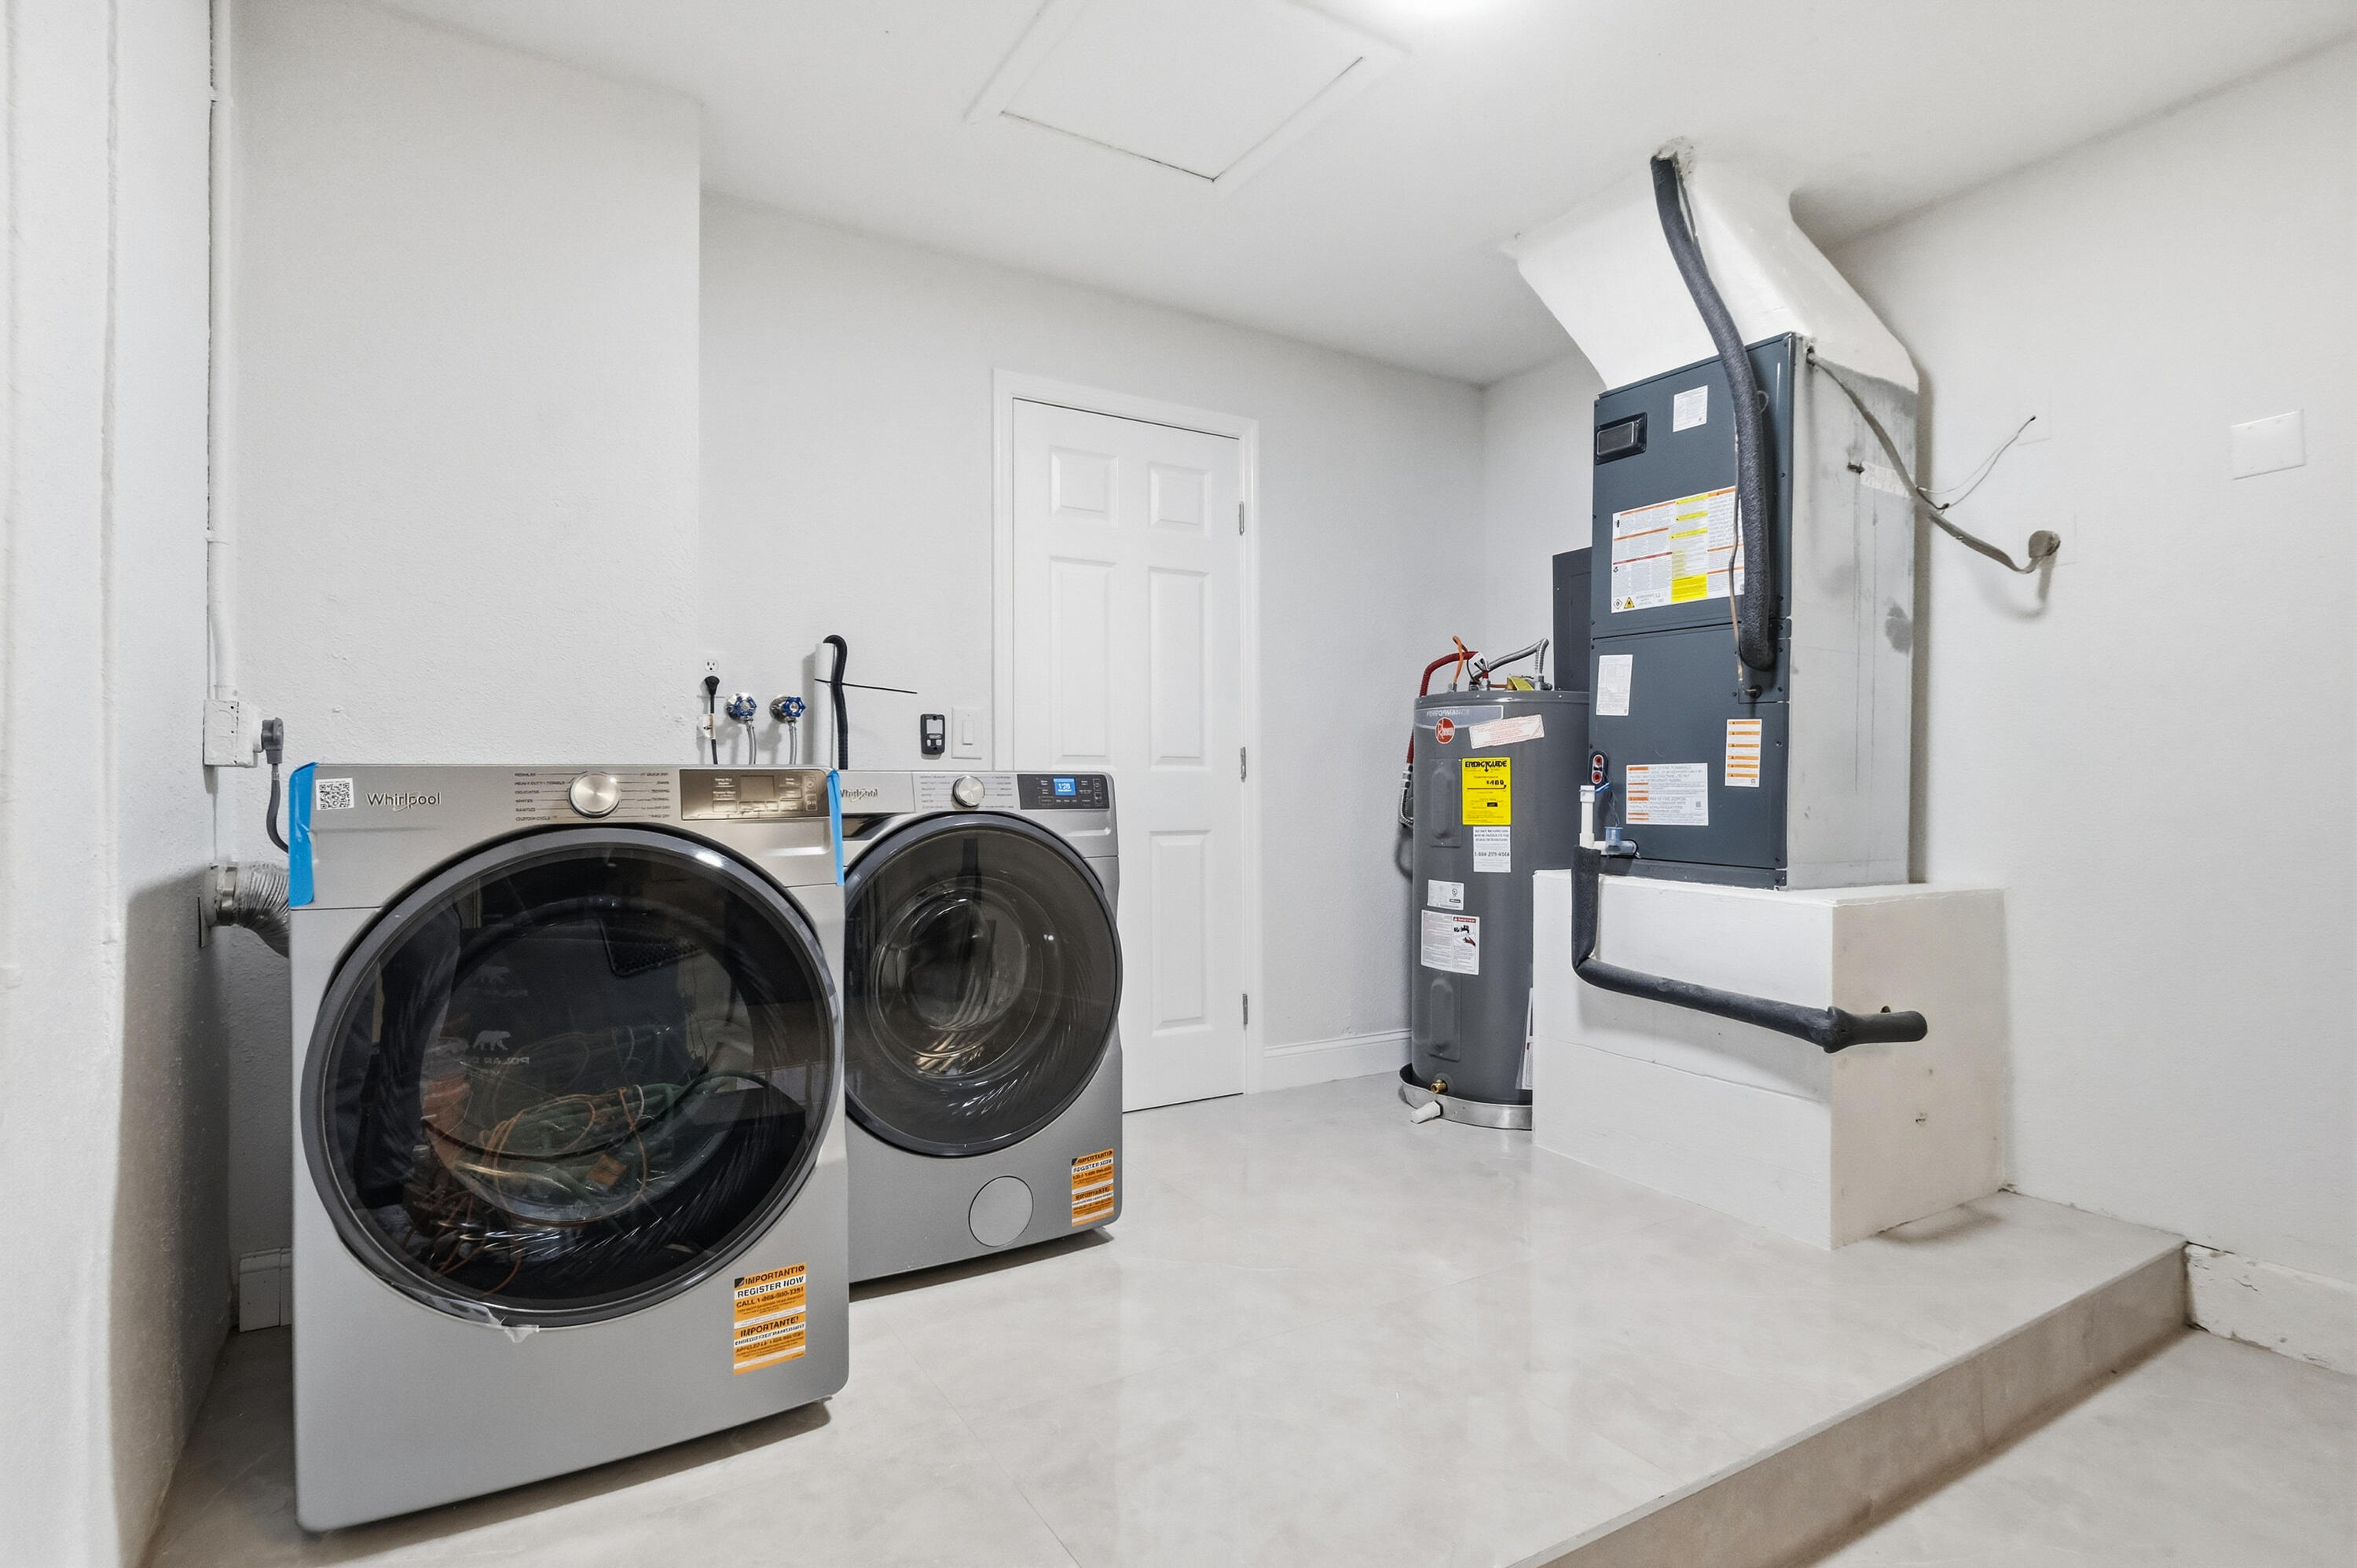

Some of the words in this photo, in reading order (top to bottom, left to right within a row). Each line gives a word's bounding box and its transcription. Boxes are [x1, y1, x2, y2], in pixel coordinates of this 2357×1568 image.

[367, 792, 441, 809] Whirlpool
[737, 1281, 781, 1299] REGISTER
[783, 1276, 804, 1288] NOW
[736, 1299, 755, 1308] CALL
